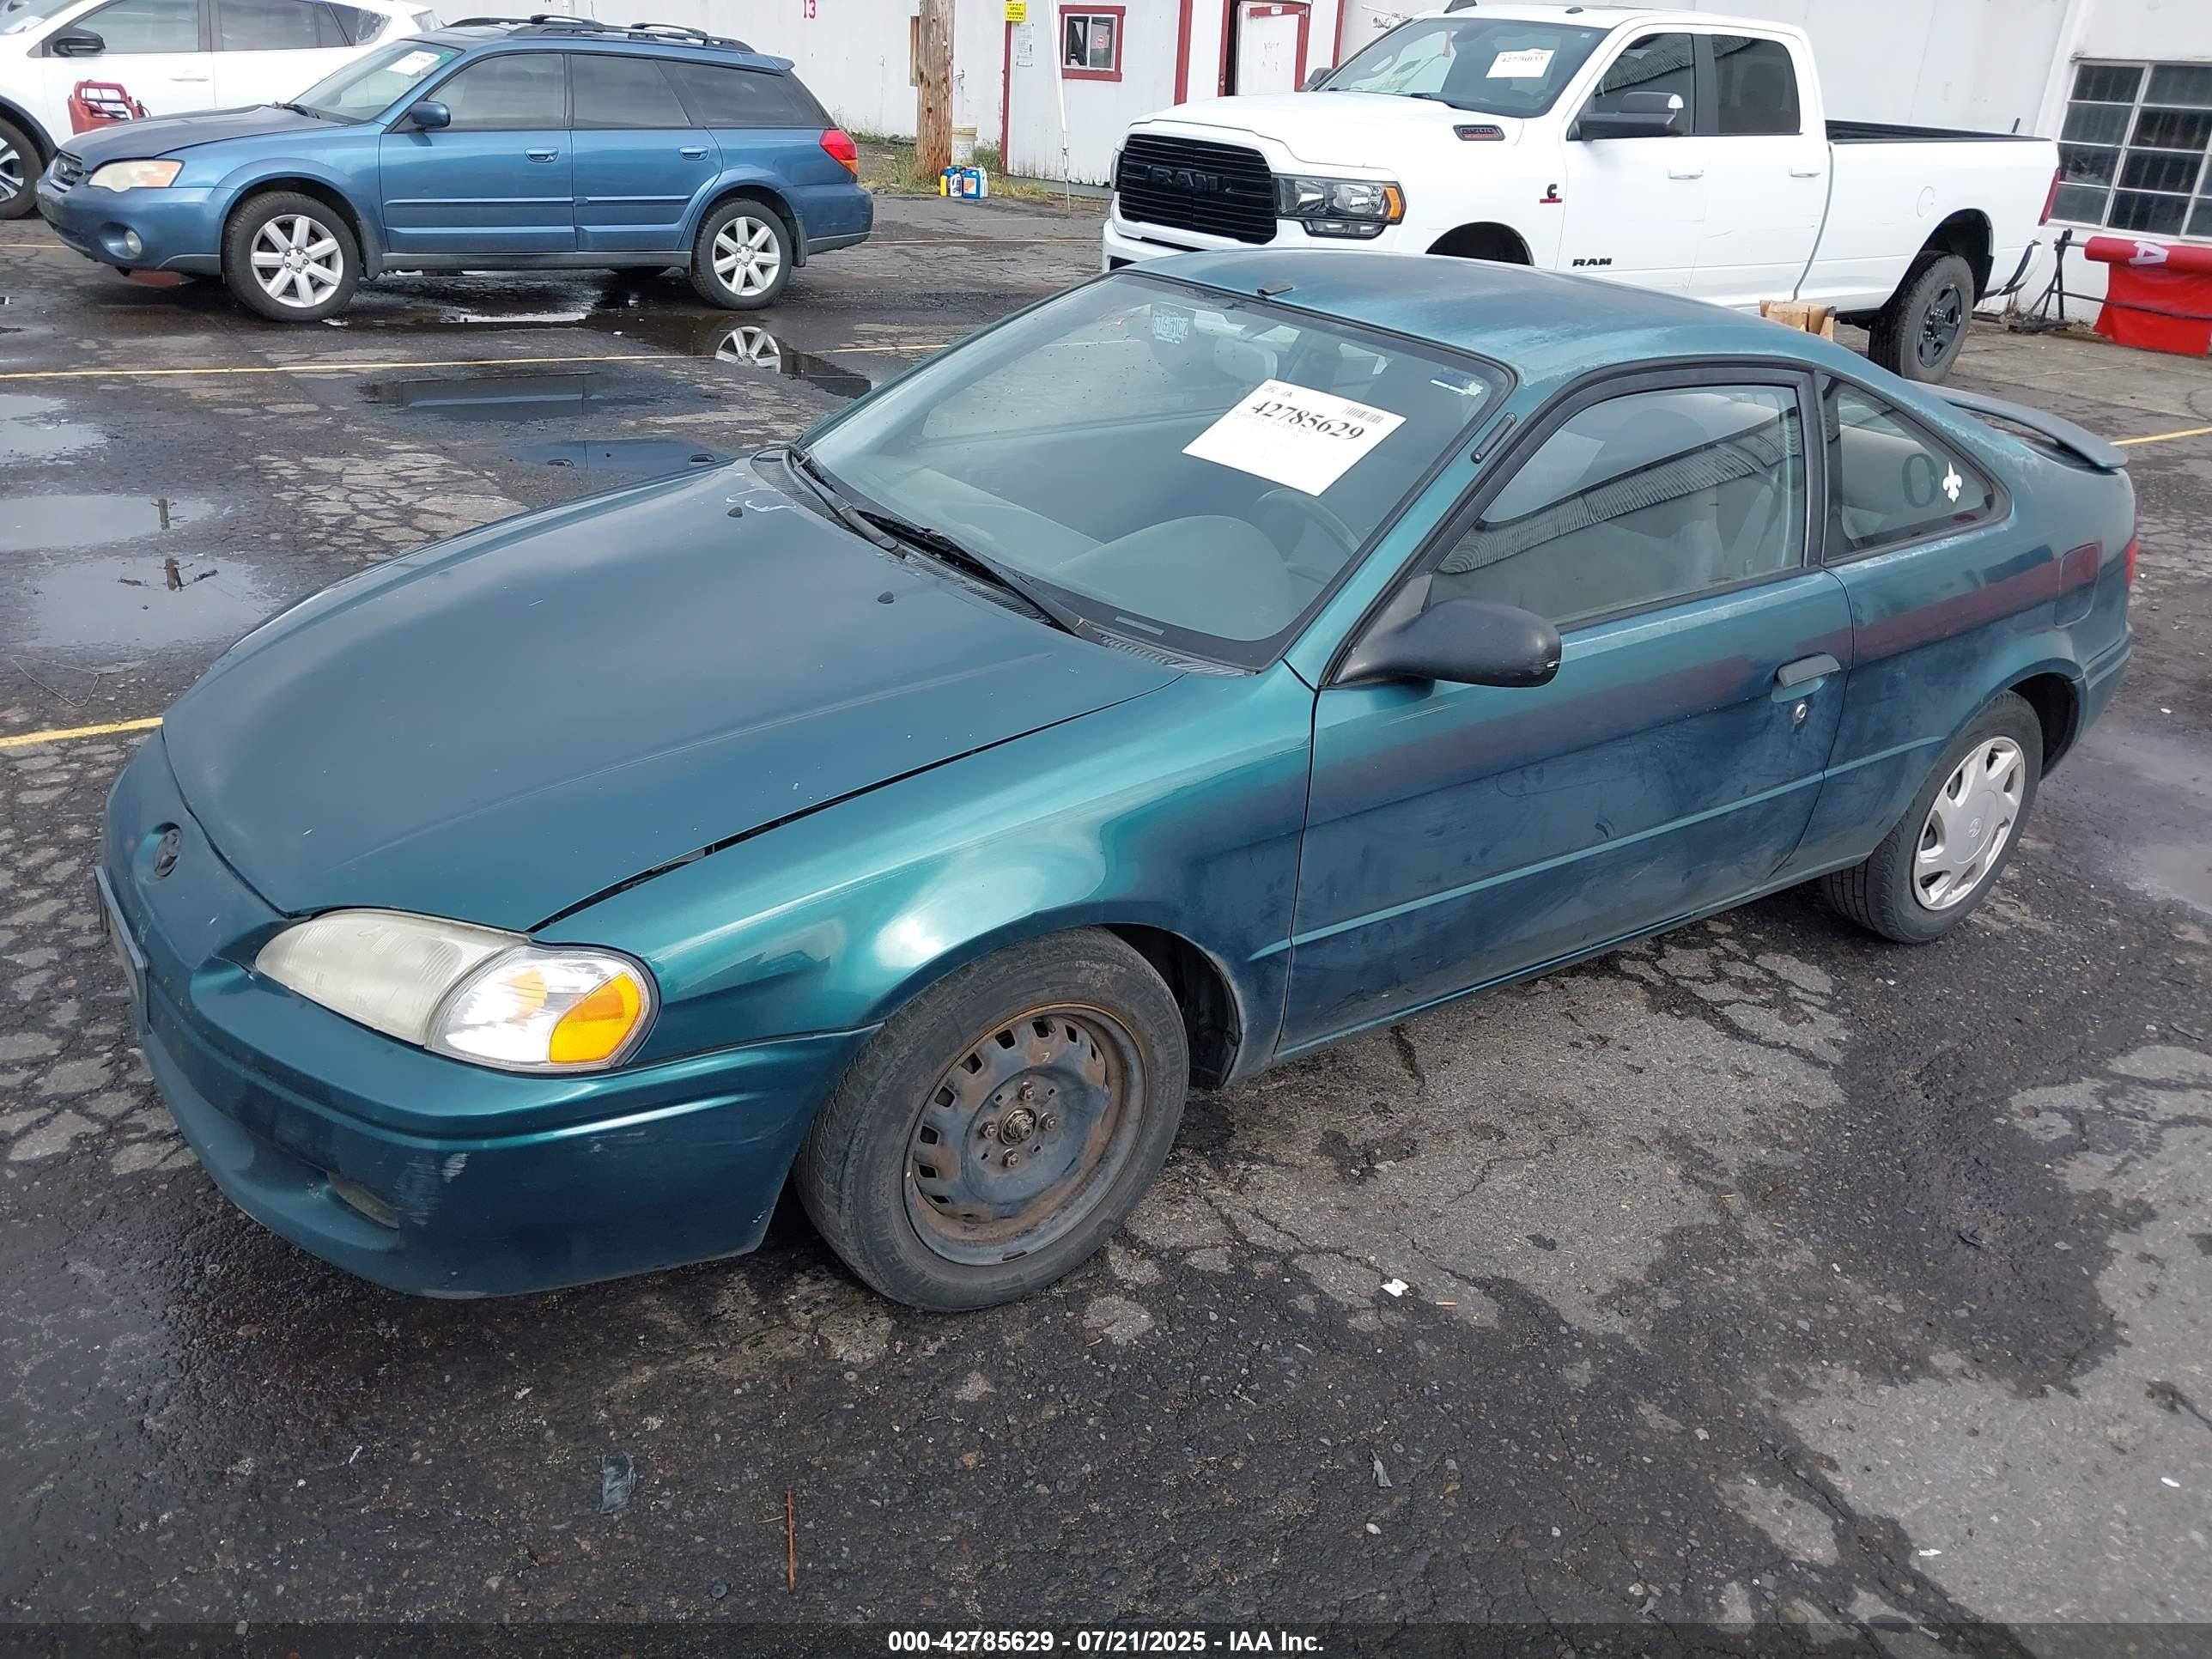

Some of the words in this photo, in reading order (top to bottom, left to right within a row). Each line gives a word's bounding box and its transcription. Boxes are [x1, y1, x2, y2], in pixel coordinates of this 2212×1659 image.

[803, 0, 817, 19] 13
[1151, 167, 1219, 193] RAM
[1571, 258, 1613, 268] RAM
[1251, 400, 1365, 441] 42785629
